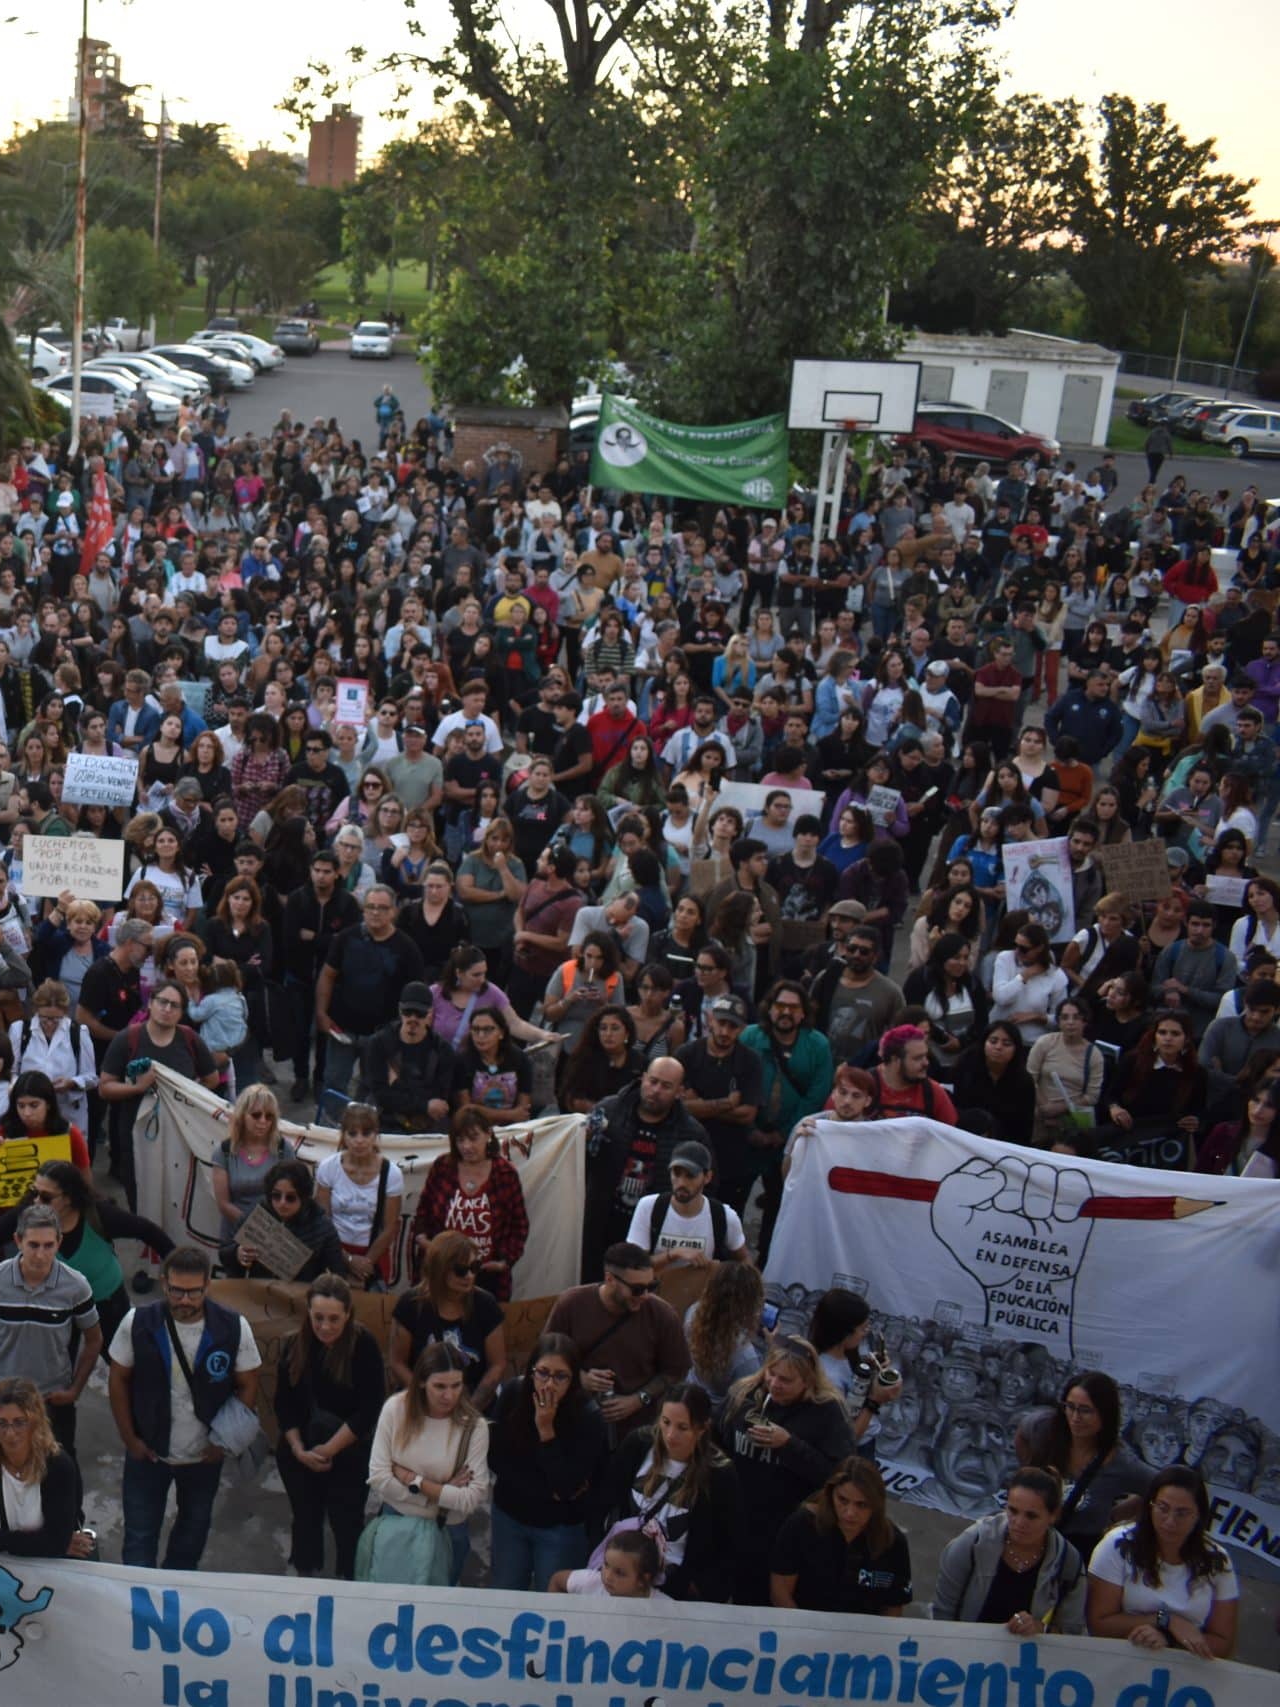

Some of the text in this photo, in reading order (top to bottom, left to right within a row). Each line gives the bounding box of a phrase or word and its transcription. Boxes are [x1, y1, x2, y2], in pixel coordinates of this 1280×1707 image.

[449, 1189, 491, 1210] NUNCA
[661, 1237, 678, 1250] RIP
[982, 1231, 1069, 1257] ASAMBLEA
[976, 1249, 1071, 1277] EN DEFENSA
[1015, 1279, 1053, 1295] DE LA
[990, 1290, 1070, 1316] EDUCACIÓN
[995, 1309, 1059, 1334] PÚBLICA
[130, 1586, 231, 1659] No
[263, 1595, 335, 1667] al
[368, 1603, 1097, 1707] desfinanciamiento
